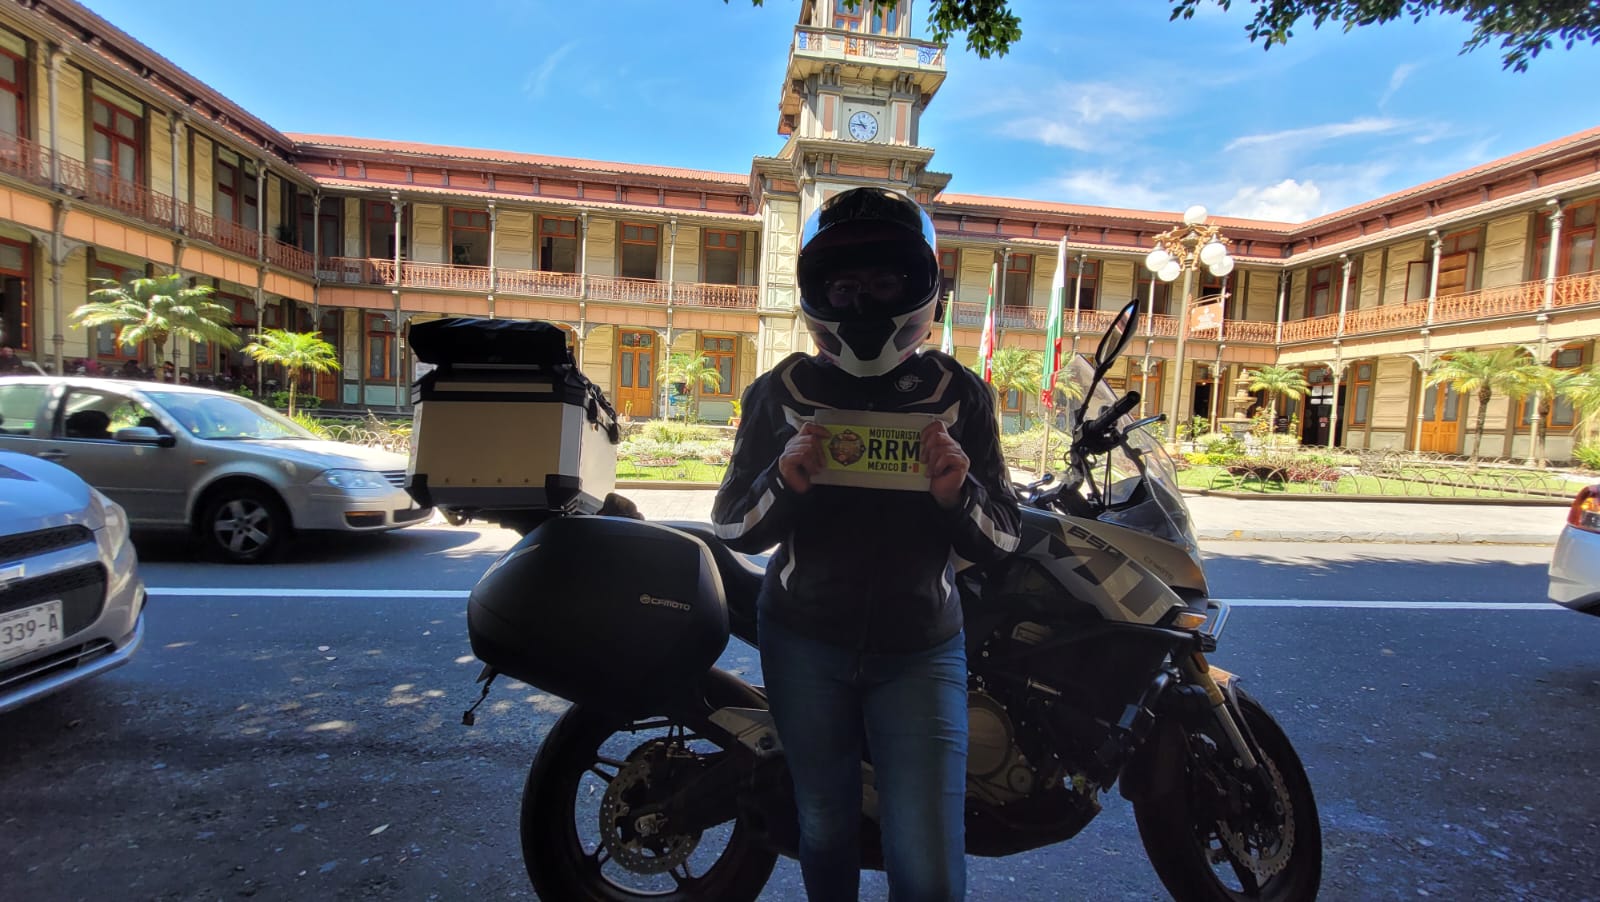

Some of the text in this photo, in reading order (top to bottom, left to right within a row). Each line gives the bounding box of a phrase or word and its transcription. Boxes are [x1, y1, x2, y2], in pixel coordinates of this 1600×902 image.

[869, 428, 921, 441] MOTOTURISTA
[868, 439, 921, 462] RRM
[651, 598, 692, 611] CFMOTO
[2, 613, 59, 645] 339-A
